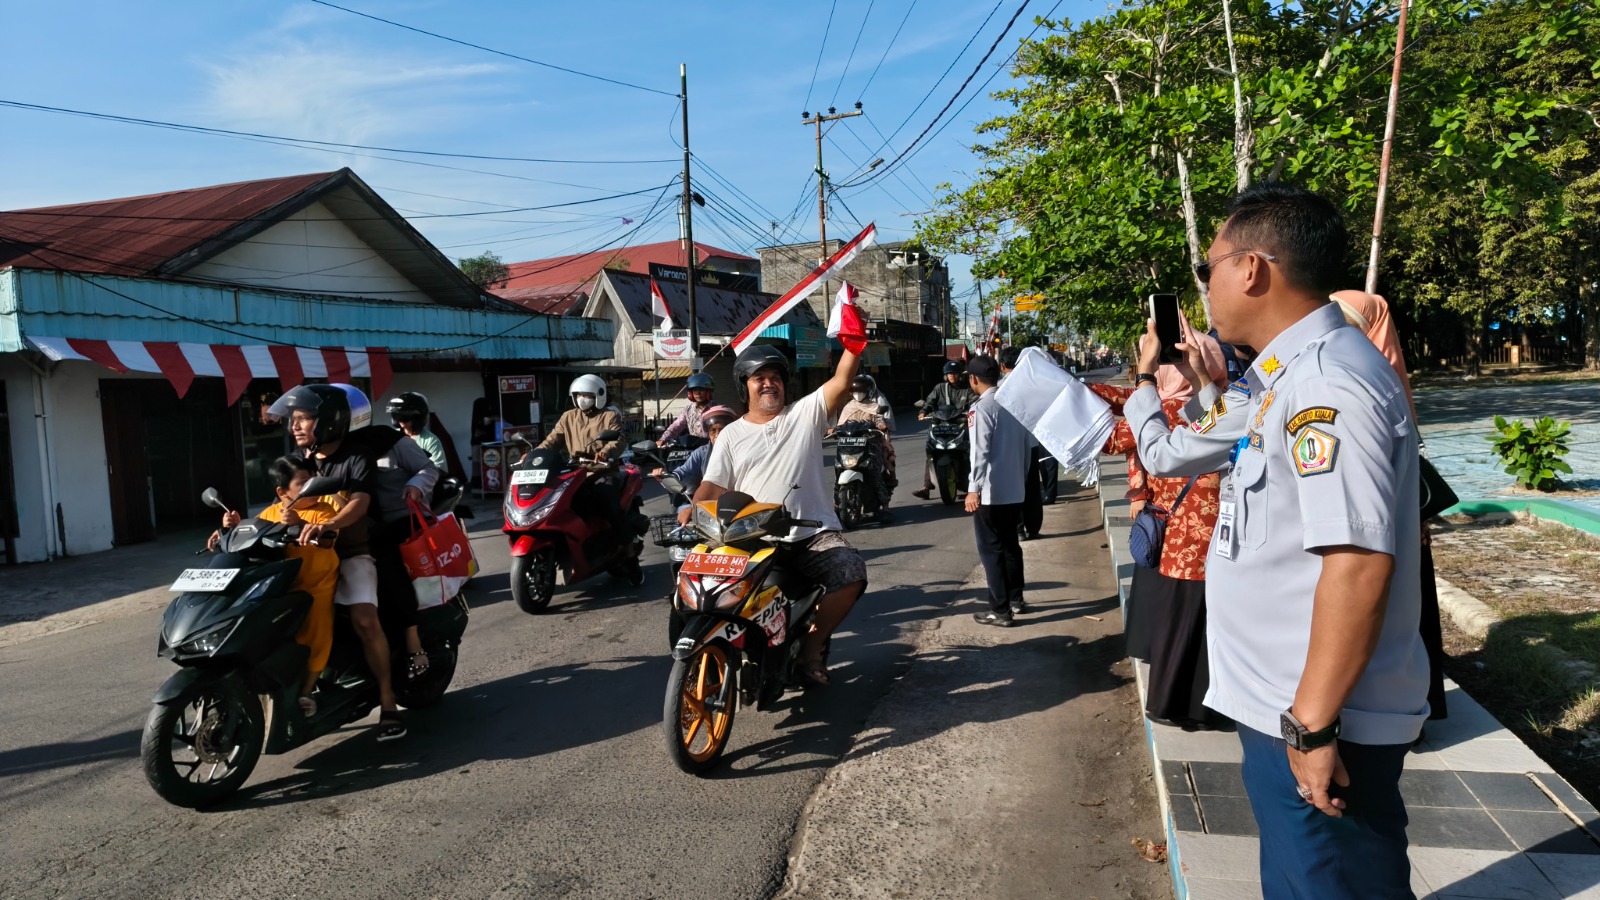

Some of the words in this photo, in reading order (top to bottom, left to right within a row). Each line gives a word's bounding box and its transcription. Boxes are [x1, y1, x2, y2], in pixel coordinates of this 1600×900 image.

[688, 554, 701, 563] DA
[704, 555, 729, 565] 2686
[730, 557, 746, 566] MK
[180, 571, 194, 579] DA
[196, 570, 221, 579] 5887
